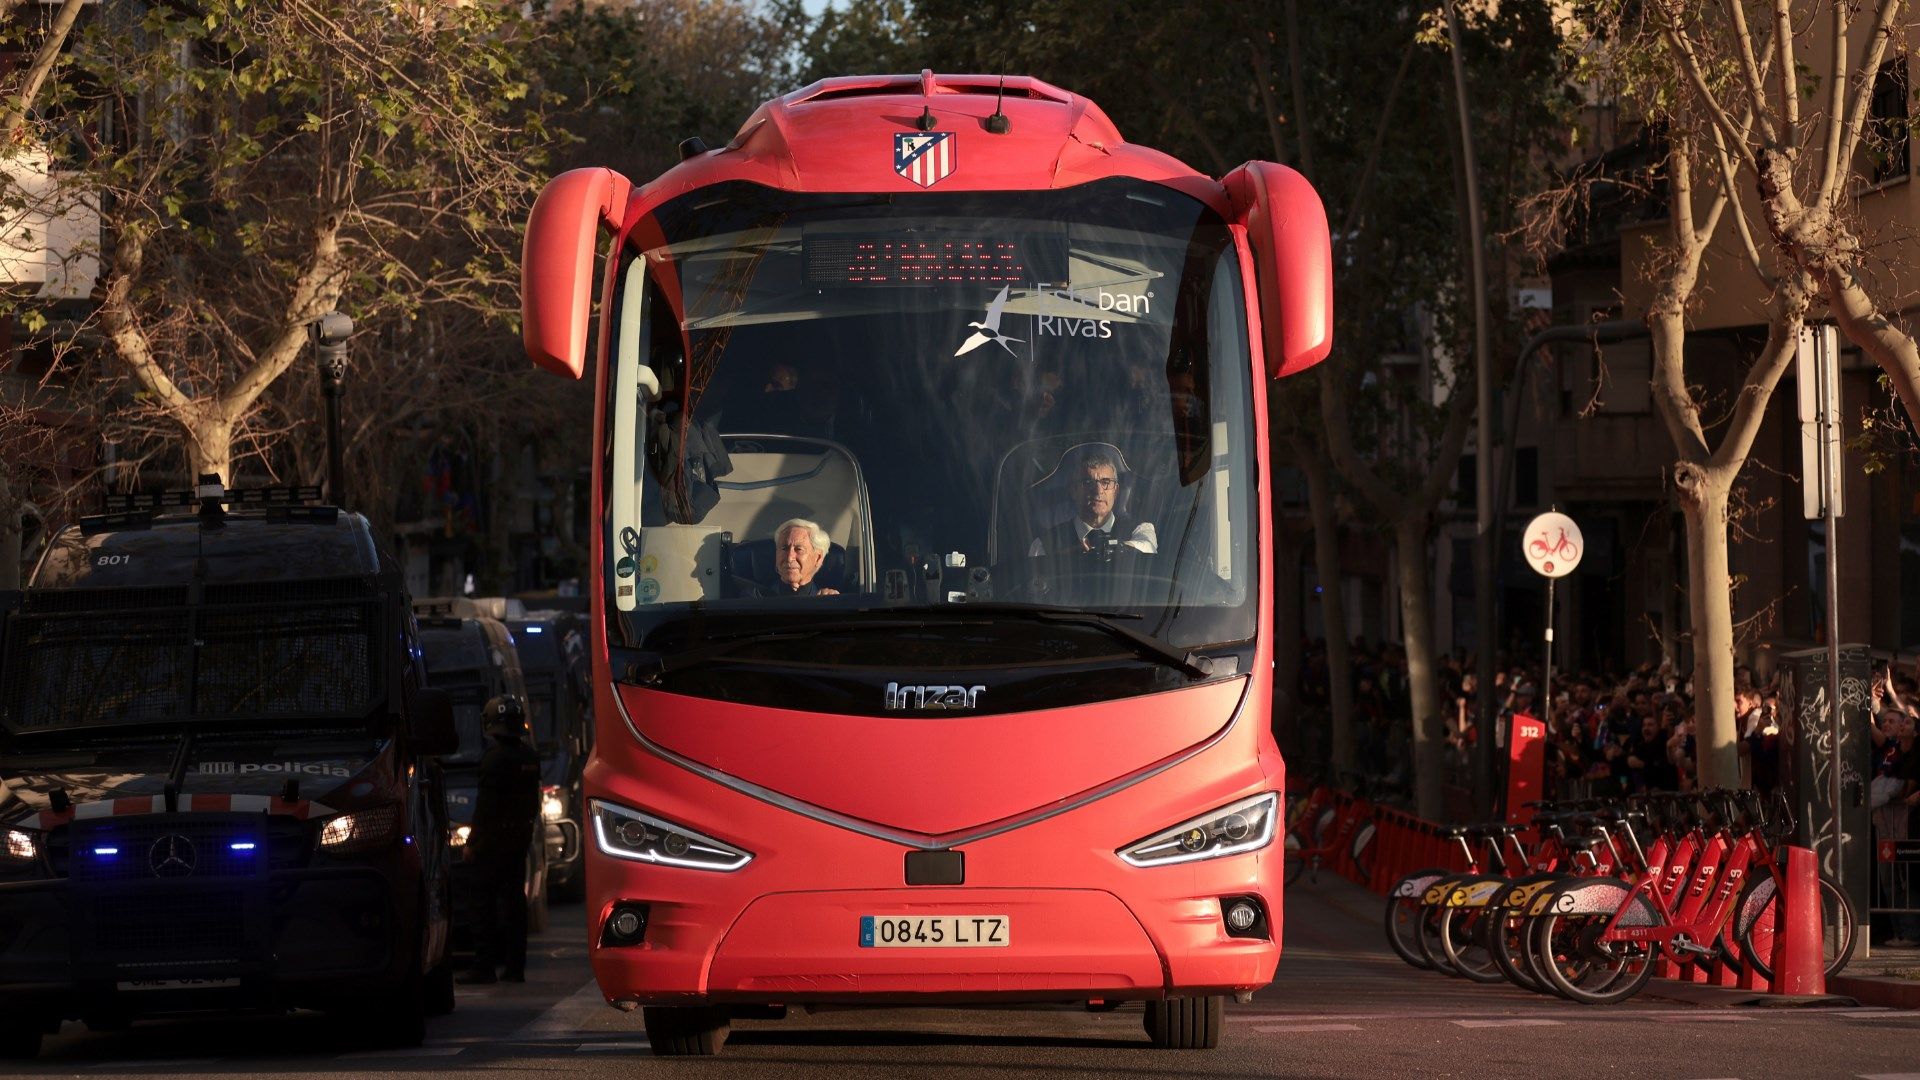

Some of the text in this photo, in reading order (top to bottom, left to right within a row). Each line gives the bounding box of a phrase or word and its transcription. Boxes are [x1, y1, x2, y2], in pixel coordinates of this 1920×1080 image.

[1037, 314, 1112, 339] Rivas
[97, 554, 130, 566] 801
[1520, 725, 1539, 738] 312
[240, 761, 350, 777] policia
[881, 918, 1002, 943] 0845 LTZ
